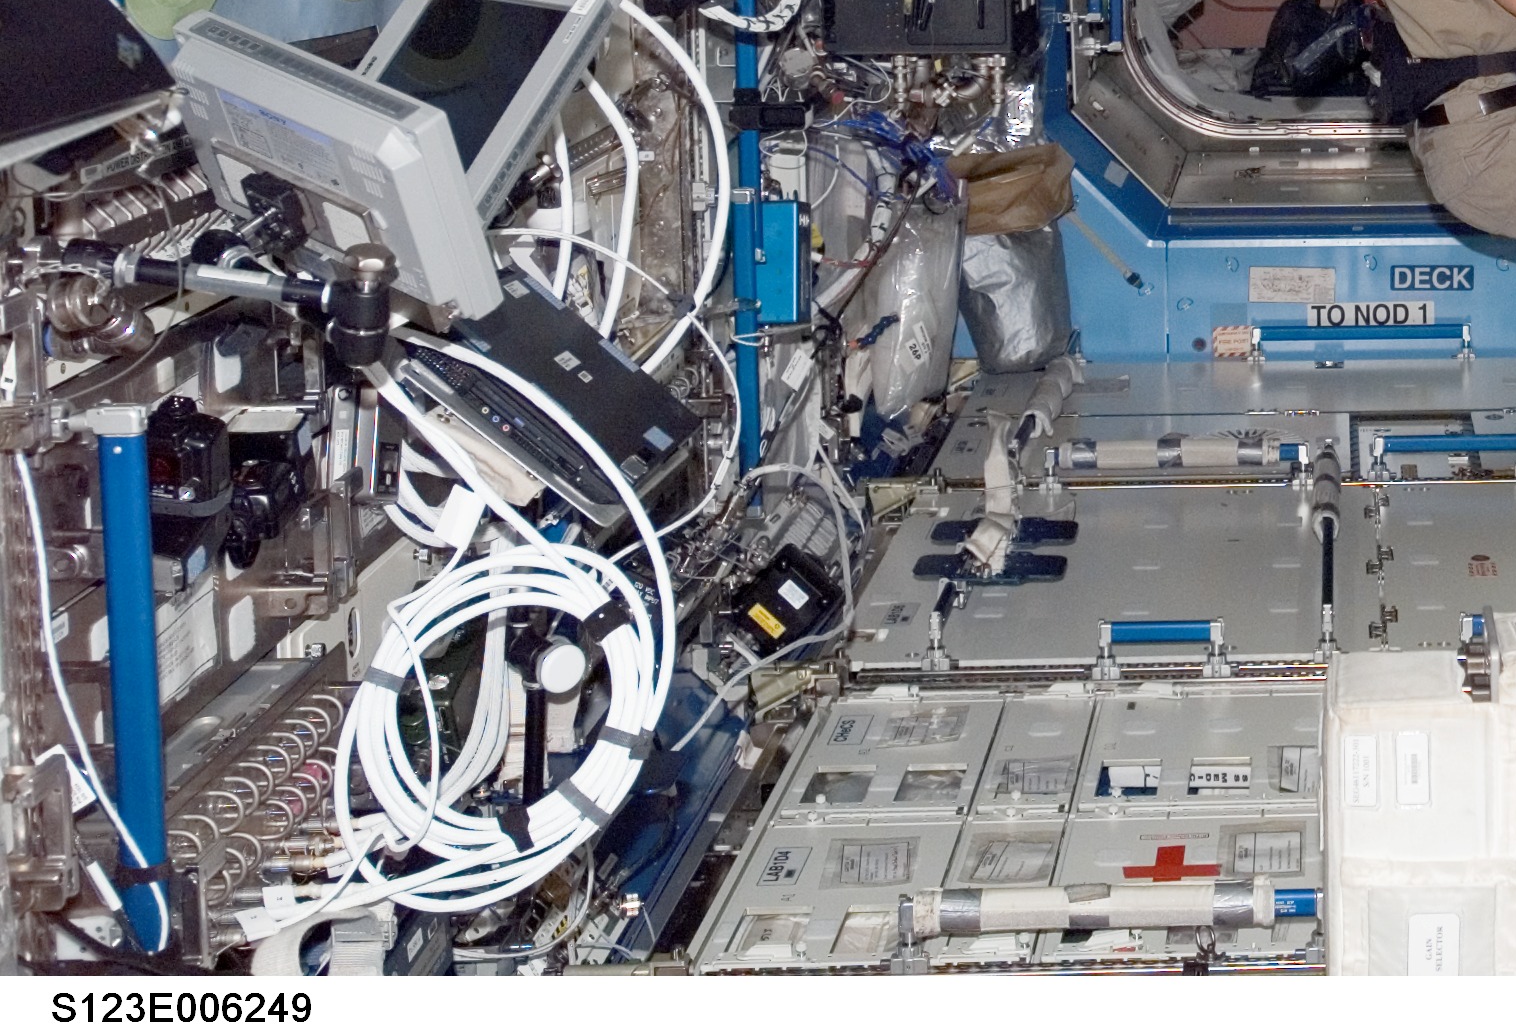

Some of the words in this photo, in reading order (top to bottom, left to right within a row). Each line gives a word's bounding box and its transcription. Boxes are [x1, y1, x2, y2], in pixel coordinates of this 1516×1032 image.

[1393, 267, 1472, 290] DECK
[1311, 305, 1346, 326] TO
[1354, 304, 1409, 326] NOD
[1417, 303, 1428, 323] 1
[908, 343, 923, 361] 26P
[833, 719, 857, 743] CHeCS
[1189, 772, 1228, 784] MEDIC
[762, 850, 792, 882] LAB1D4
[1425, 937, 1433, 961] GAIN
[1435, 925, 1444, 972] SELECTOR
